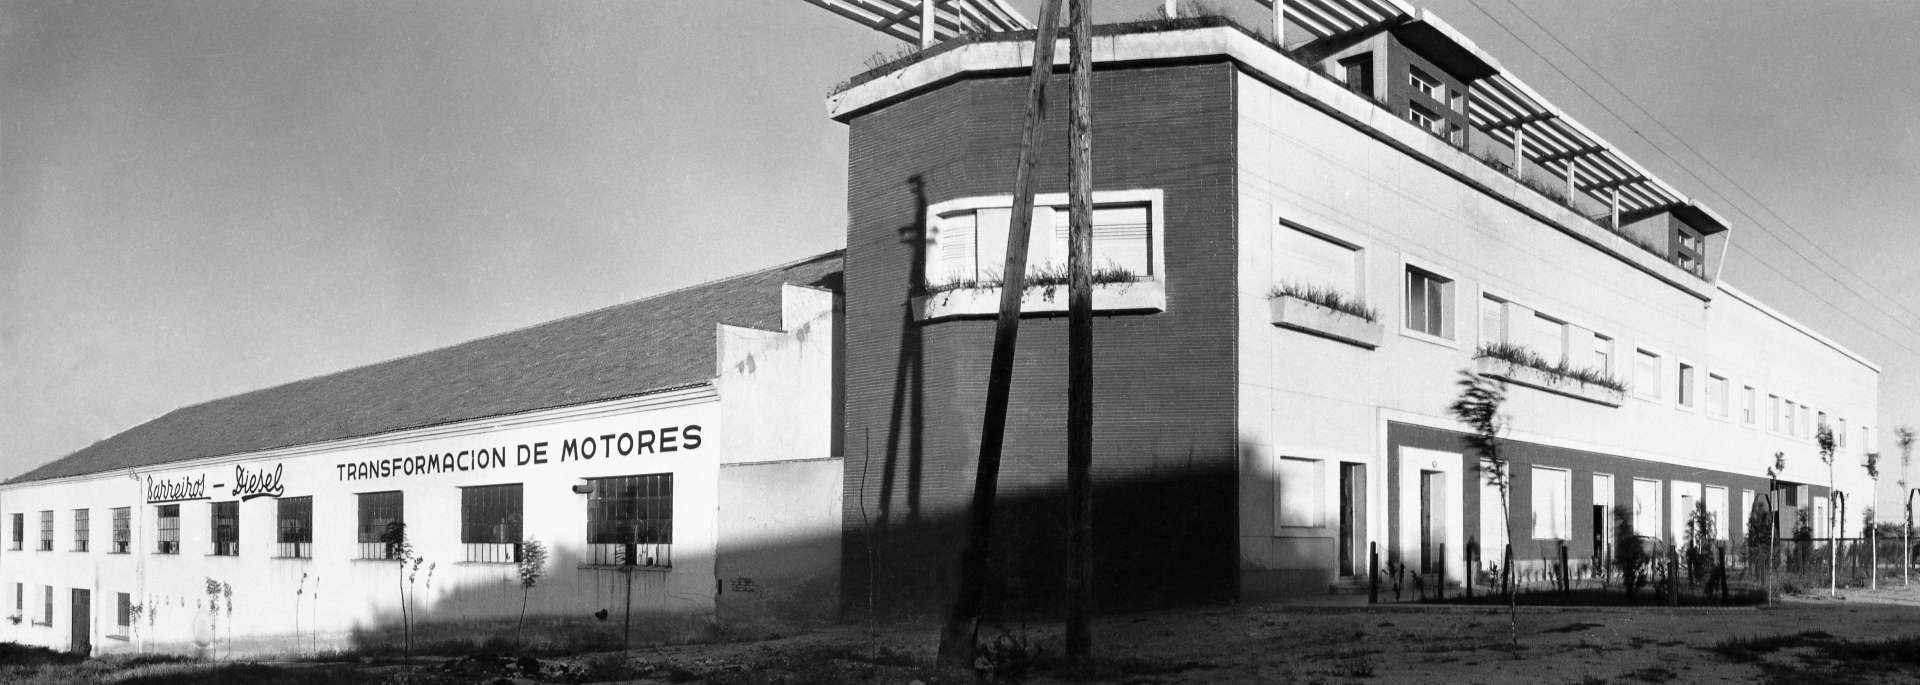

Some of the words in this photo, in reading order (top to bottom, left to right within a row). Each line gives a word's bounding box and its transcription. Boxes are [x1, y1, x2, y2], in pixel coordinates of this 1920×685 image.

[336, 446, 506, 481] TRANSFORMACION
[517, 441, 549, 465] DE
[560, 424, 702, 462] MOTORES
[146, 473, 208, 503] Barreiros
[232, 463, 284, 501] Diesel
